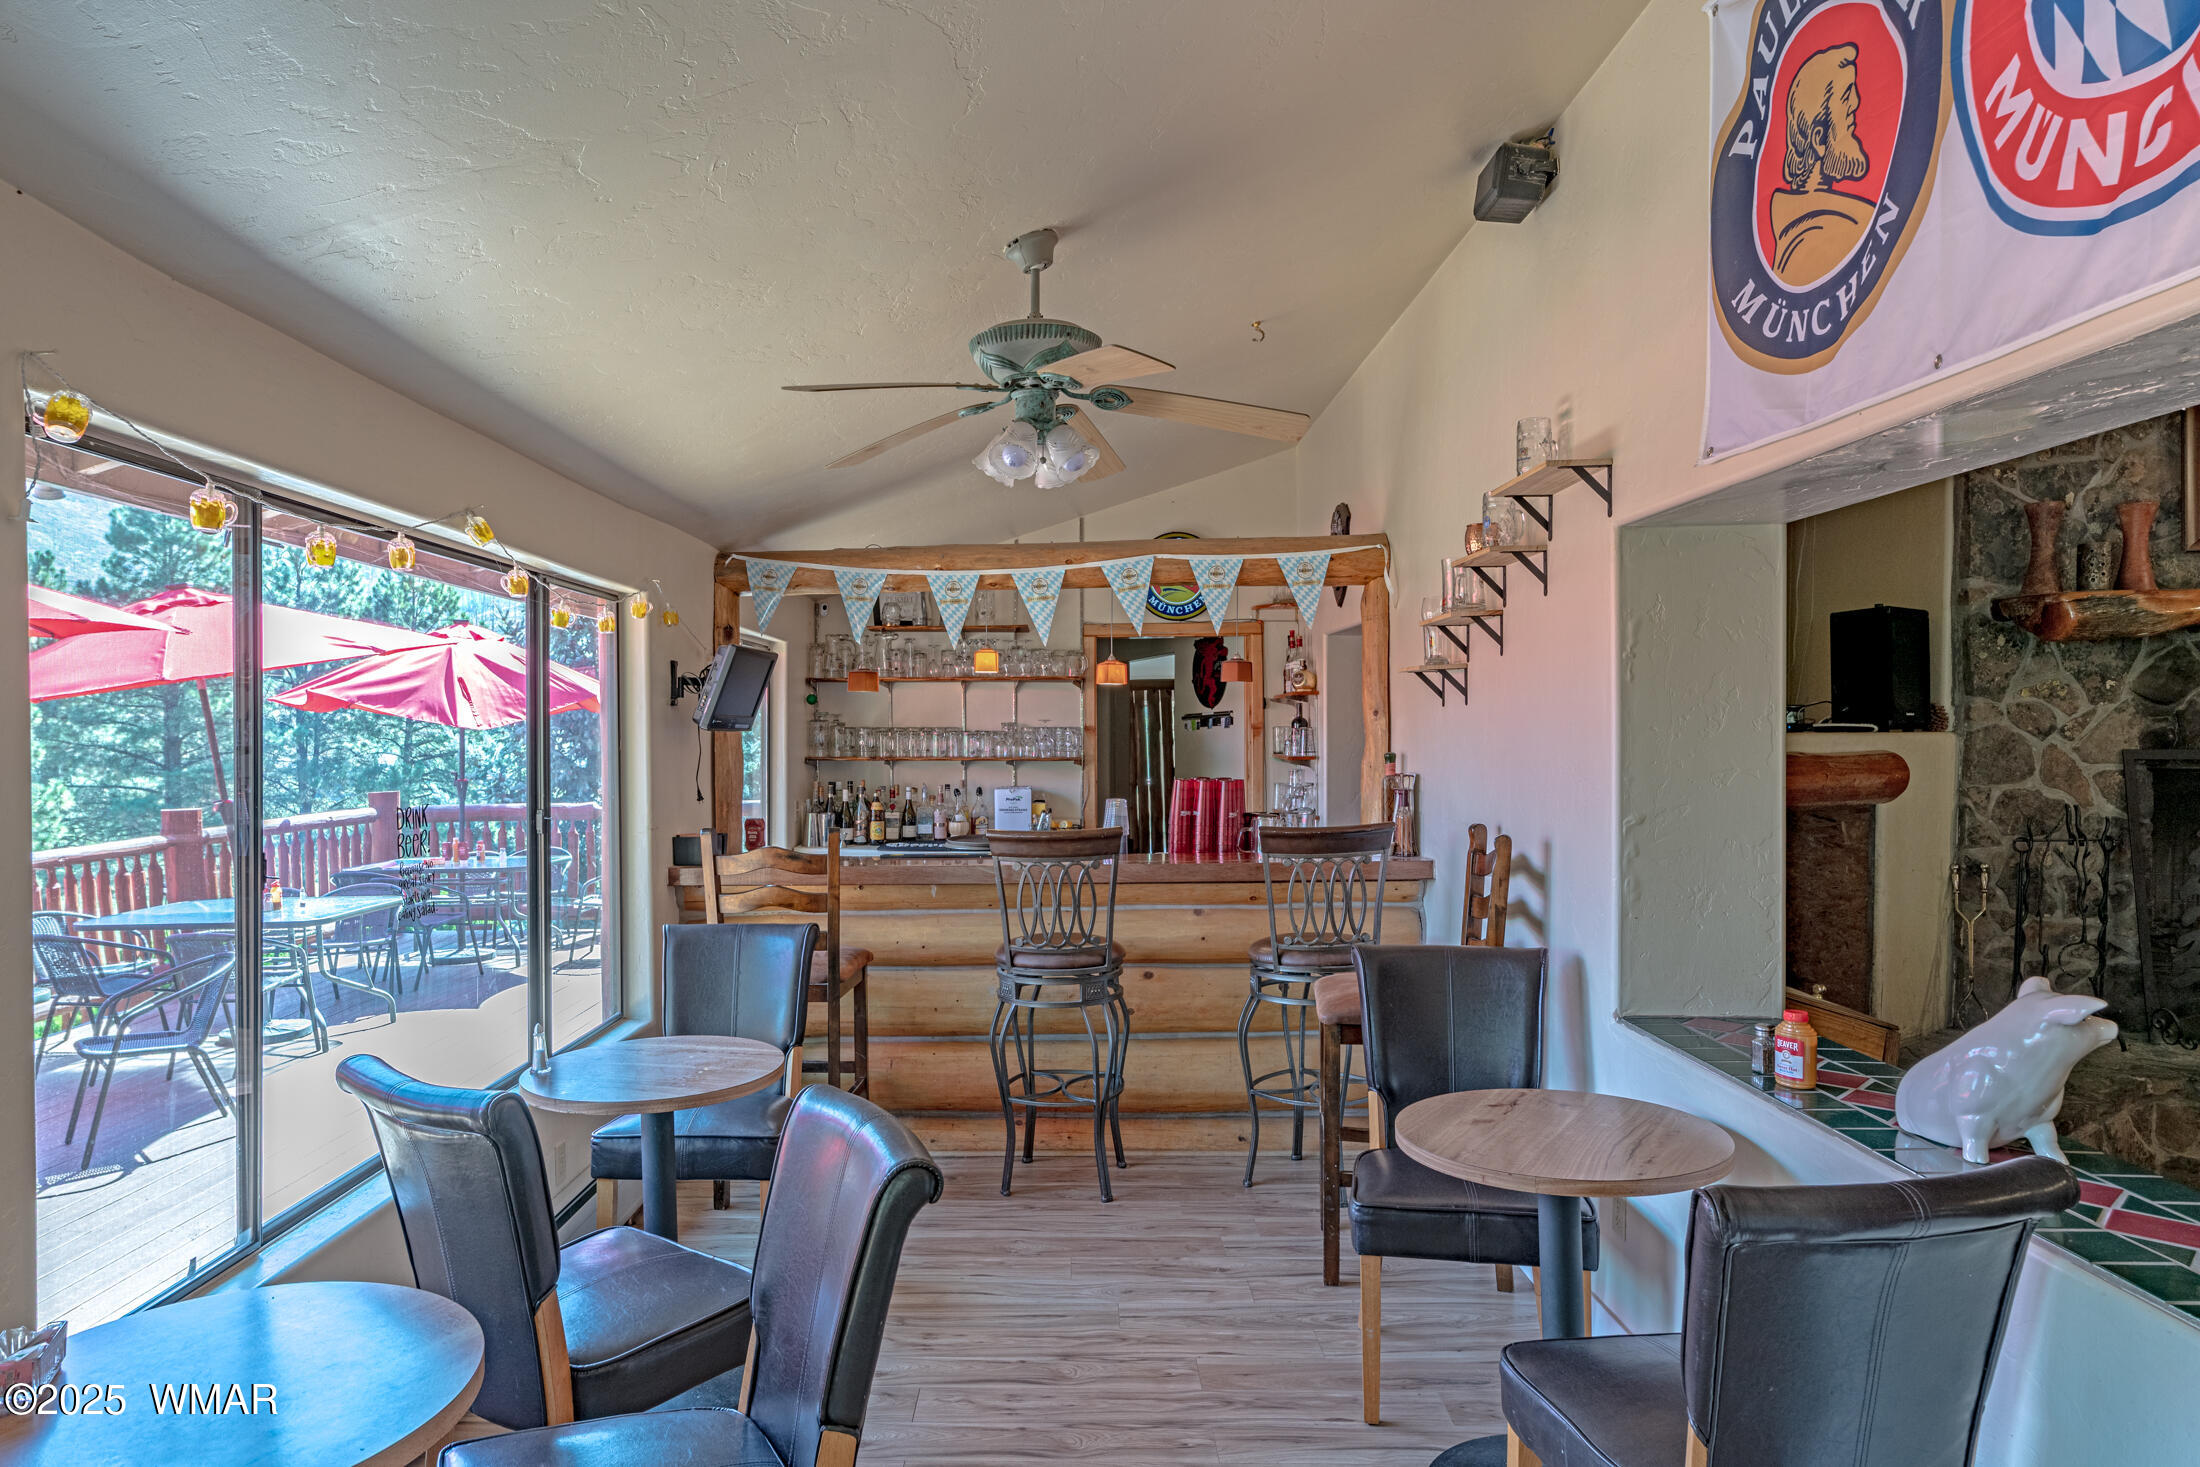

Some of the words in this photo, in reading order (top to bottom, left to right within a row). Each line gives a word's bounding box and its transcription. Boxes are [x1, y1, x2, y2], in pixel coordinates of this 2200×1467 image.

[1984, 52, 2200, 191] MÜNC
[1731, 192, 1899, 343] MÜNCHEN
[397, 804, 429, 830] DRINK
[1777, 1039, 1798, 1051] BEAVER
